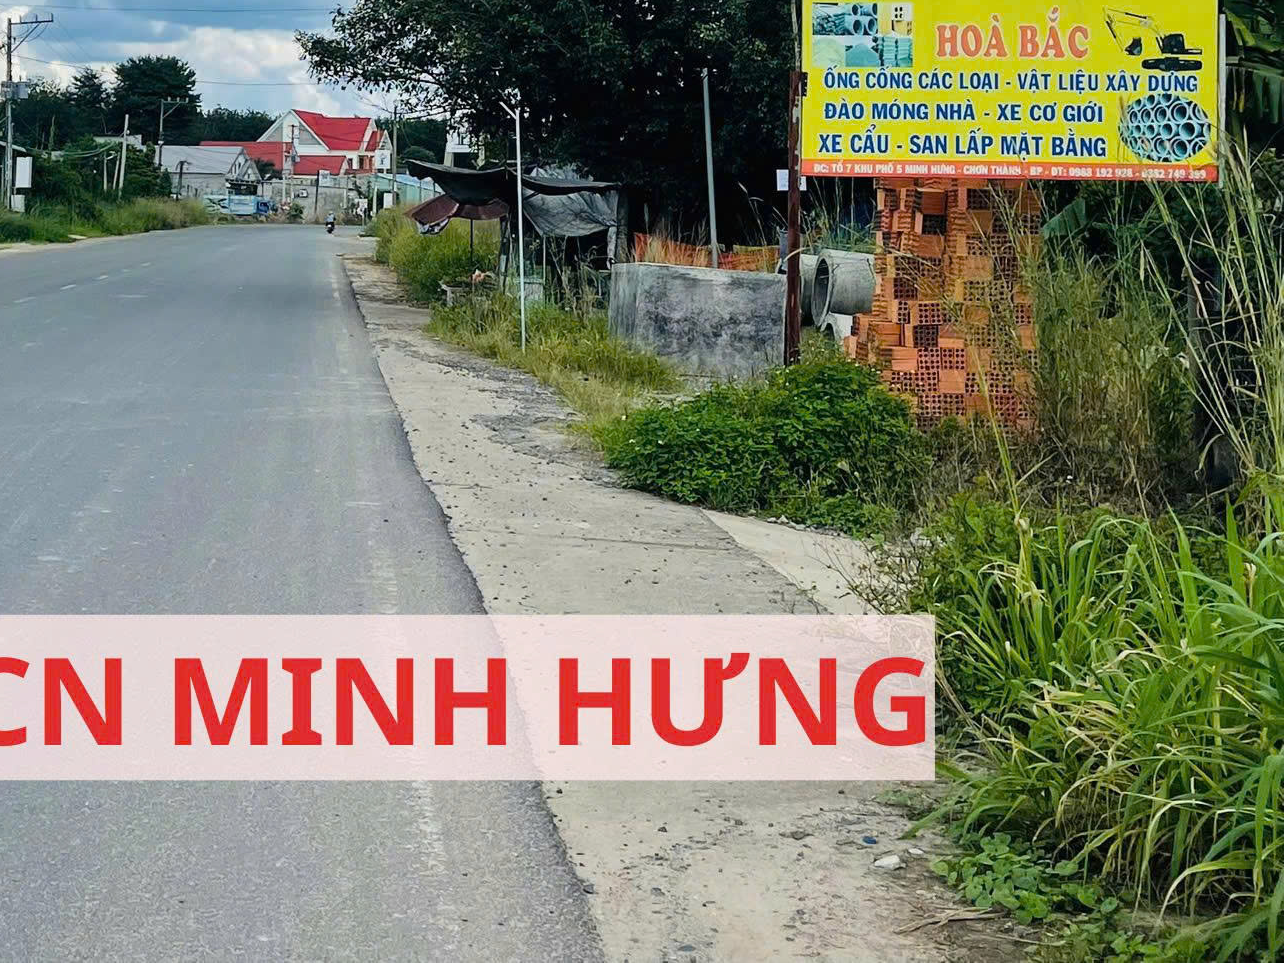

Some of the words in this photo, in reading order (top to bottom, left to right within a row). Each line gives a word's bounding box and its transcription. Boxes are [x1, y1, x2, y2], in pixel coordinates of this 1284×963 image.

[937, 14, 1009, 59] HOÀ
[1019, 7, 1089, 59] BẮC
[824, 65, 859, 89] ỐNG
[866, 64, 912, 90] CỐNG
[919, 70, 953, 90] CÁC
[960, 73, 999, 92] LOẠI
[1018, 69, 1052, 93] VẬT
[1059, 70, 1099, 93] LIỆU
[1106, 69, 1141, 92] XÂY
[1148, 73, 1199, 94] DỰNG
[824, 100, 864, 120] ĐÀO
[872, 99, 928, 121] MÓNG
[937, 100, 975, 121] NHÀ
[998, 104, 1022, 121] XE
[1030, 104, 1057, 122] CƠ
[1063, 101, 1103, 123] GIỚI
[819, 134, 843, 153] XE
[851, 124, 889, 154] CẨU
[910, 134, 947, 155] SAN
[955, 127, 993, 155] LẤP
[1001, 134, 1044, 161] MẶT
[1052, 129, 1106, 157] BẰNG
[846, 164, 852, 174] 7
[854, 164, 873, 174] KHU
[875, 162, 894, 174] PHỐ
[896, 165, 903, 174] 5
[905, 165, 928, 174] MINH
[1030, 166, 1044, 176] BP
